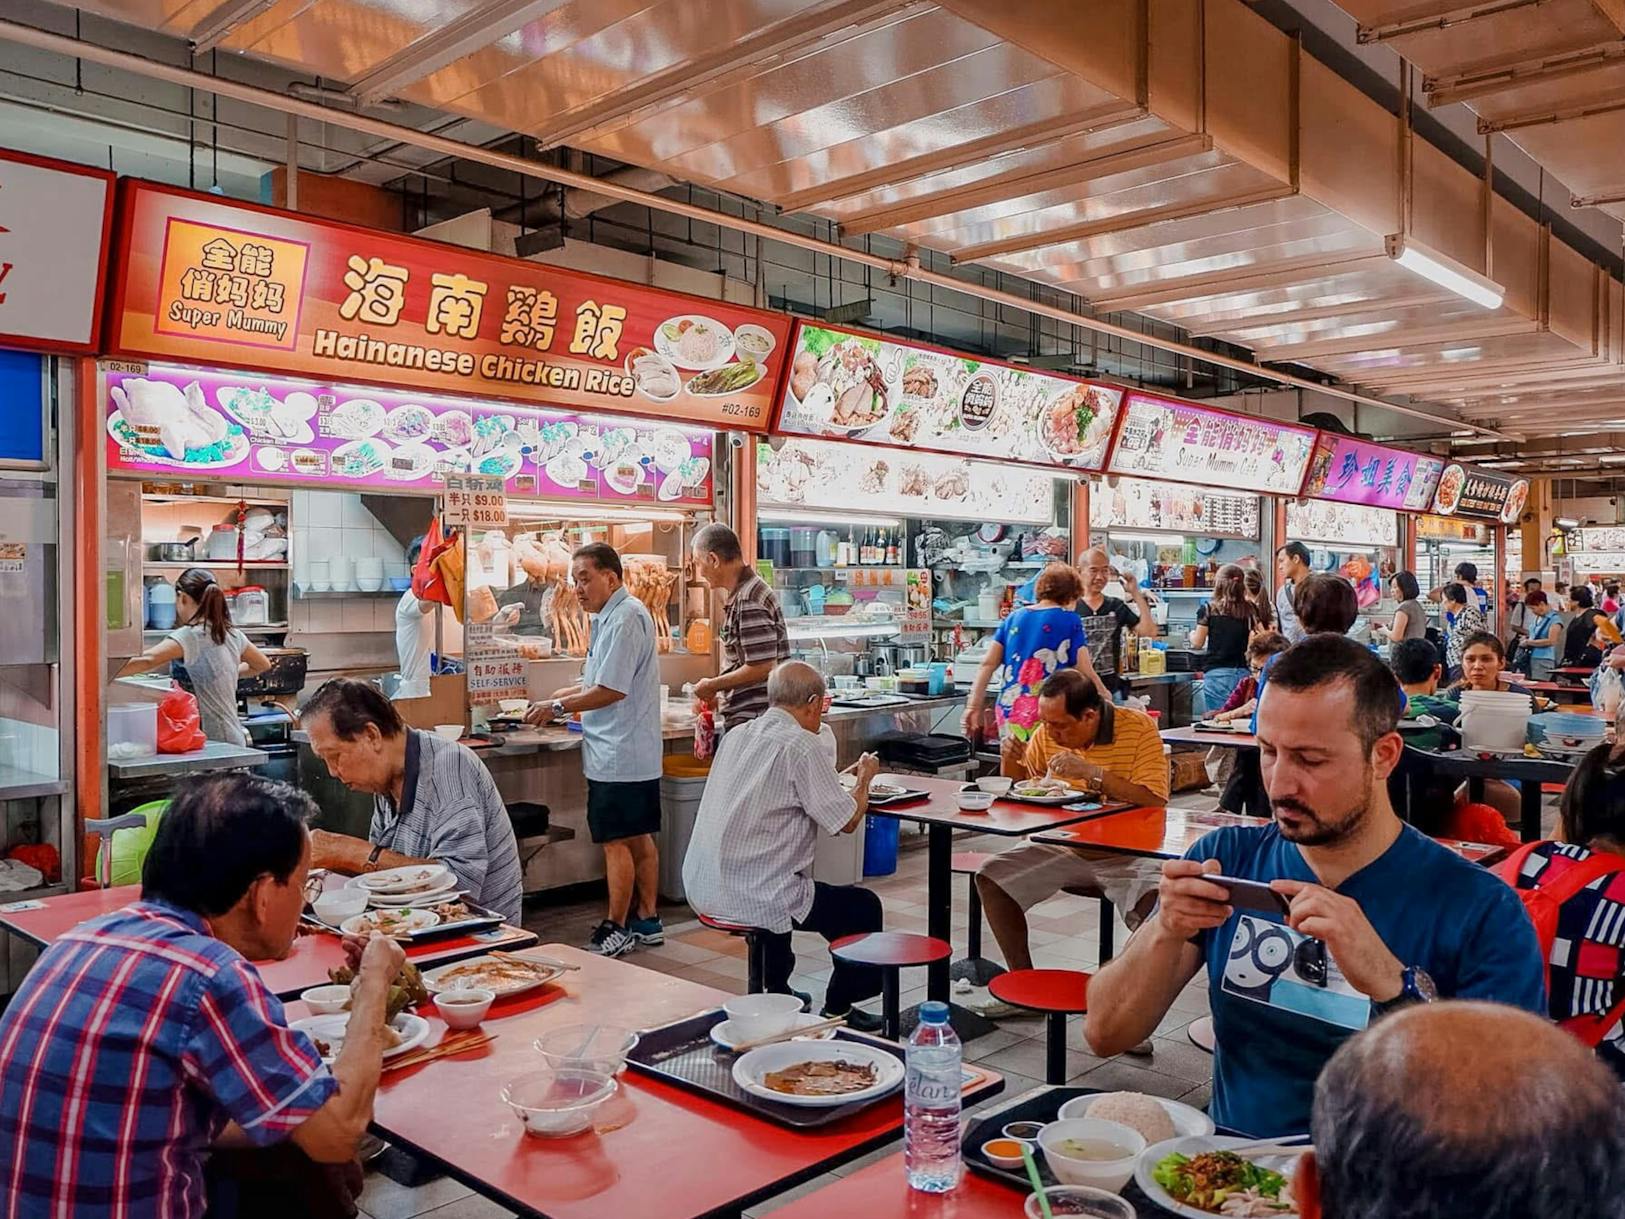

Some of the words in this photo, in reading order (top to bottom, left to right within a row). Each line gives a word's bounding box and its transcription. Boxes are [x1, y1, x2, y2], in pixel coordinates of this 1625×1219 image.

[201, 238, 274, 277] 全能
[181, 268, 285, 314] 俏妈妈
[169, 302, 220, 329] Super
[226, 311, 288, 340] Mummy
[110, 362, 141, 374] 02-169
[313, 329, 475, 375] Hainanese
[480, 354, 580, 389] Chicken
[584, 368, 635, 396] Rice
[721, 403, 760, 418] #02-169
[1175, 446, 1204, 469] Super
[449, 491, 471, 506] 半只
[474, 494, 504, 506] $9.00
[473, 509, 505, 522] $18.00
[470, 676, 527, 689] SELF-SERVICE
